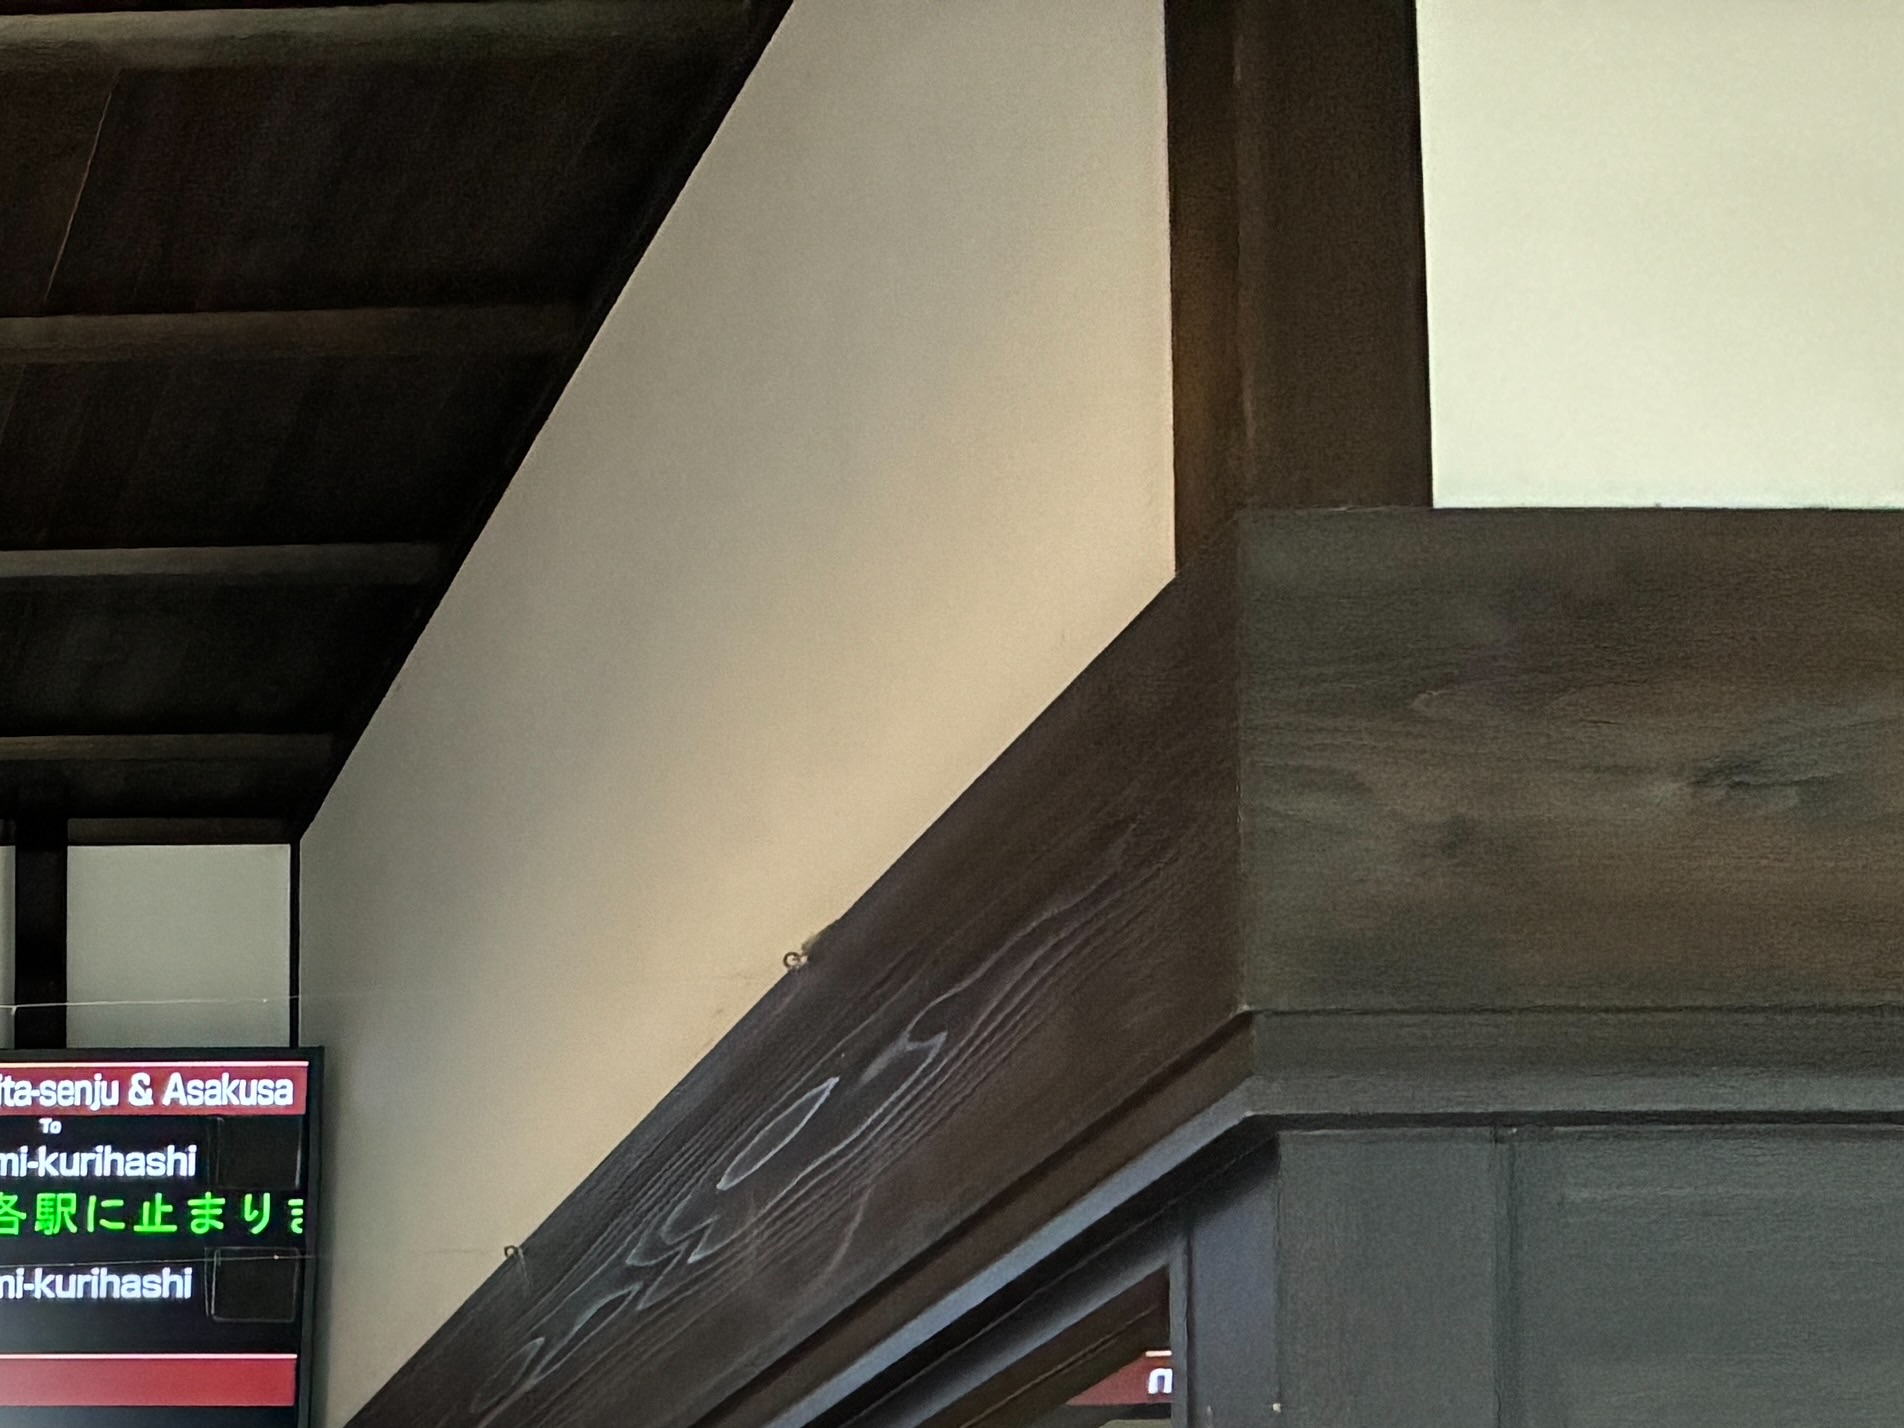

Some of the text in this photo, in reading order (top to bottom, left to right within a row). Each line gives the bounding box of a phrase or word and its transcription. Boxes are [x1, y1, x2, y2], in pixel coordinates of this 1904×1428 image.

[128, 1074, 152, 1107] &
[161, 1072, 293, 1107] Asakusa
[40, 1119, 61, 1135] To
